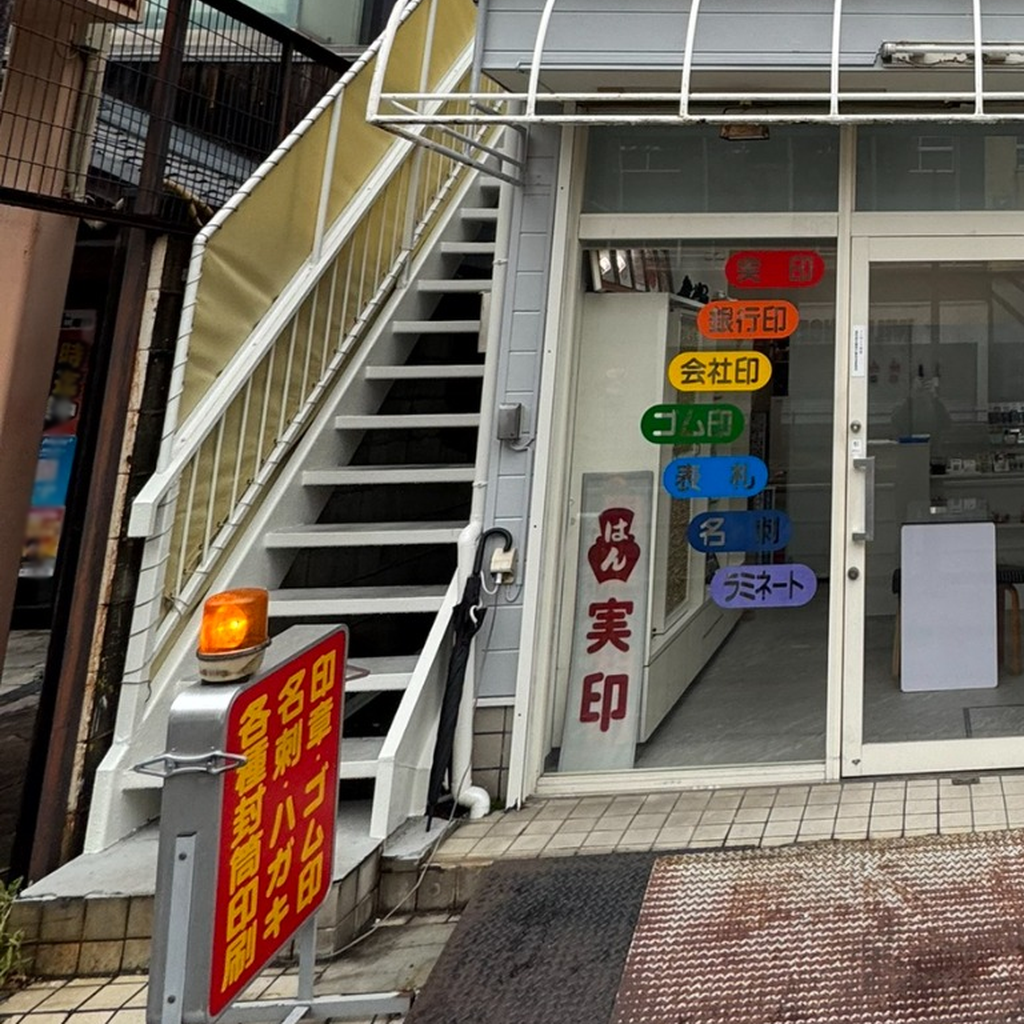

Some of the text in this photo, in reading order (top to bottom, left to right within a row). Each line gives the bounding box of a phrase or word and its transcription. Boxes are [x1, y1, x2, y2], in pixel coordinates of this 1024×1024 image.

[708, 306, 787, 334] 銀行印
[680, 357, 759, 386] 会社印
[653, 409, 733, 438] ゴム印
[675, 464, 756, 491] 表札
[600, 518, 629, 571] はん
[699, 517, 780, 547] 名刺
[723, 570, 804, 603] ラミネート
[579, 597, 634, 733] 実印
[296, 649, 336, 913] 印章・ゴム印
[263, 668, 305, 939] 名刺・ハガキ
[221, 693, 271, 993] 各種封筒印刷
